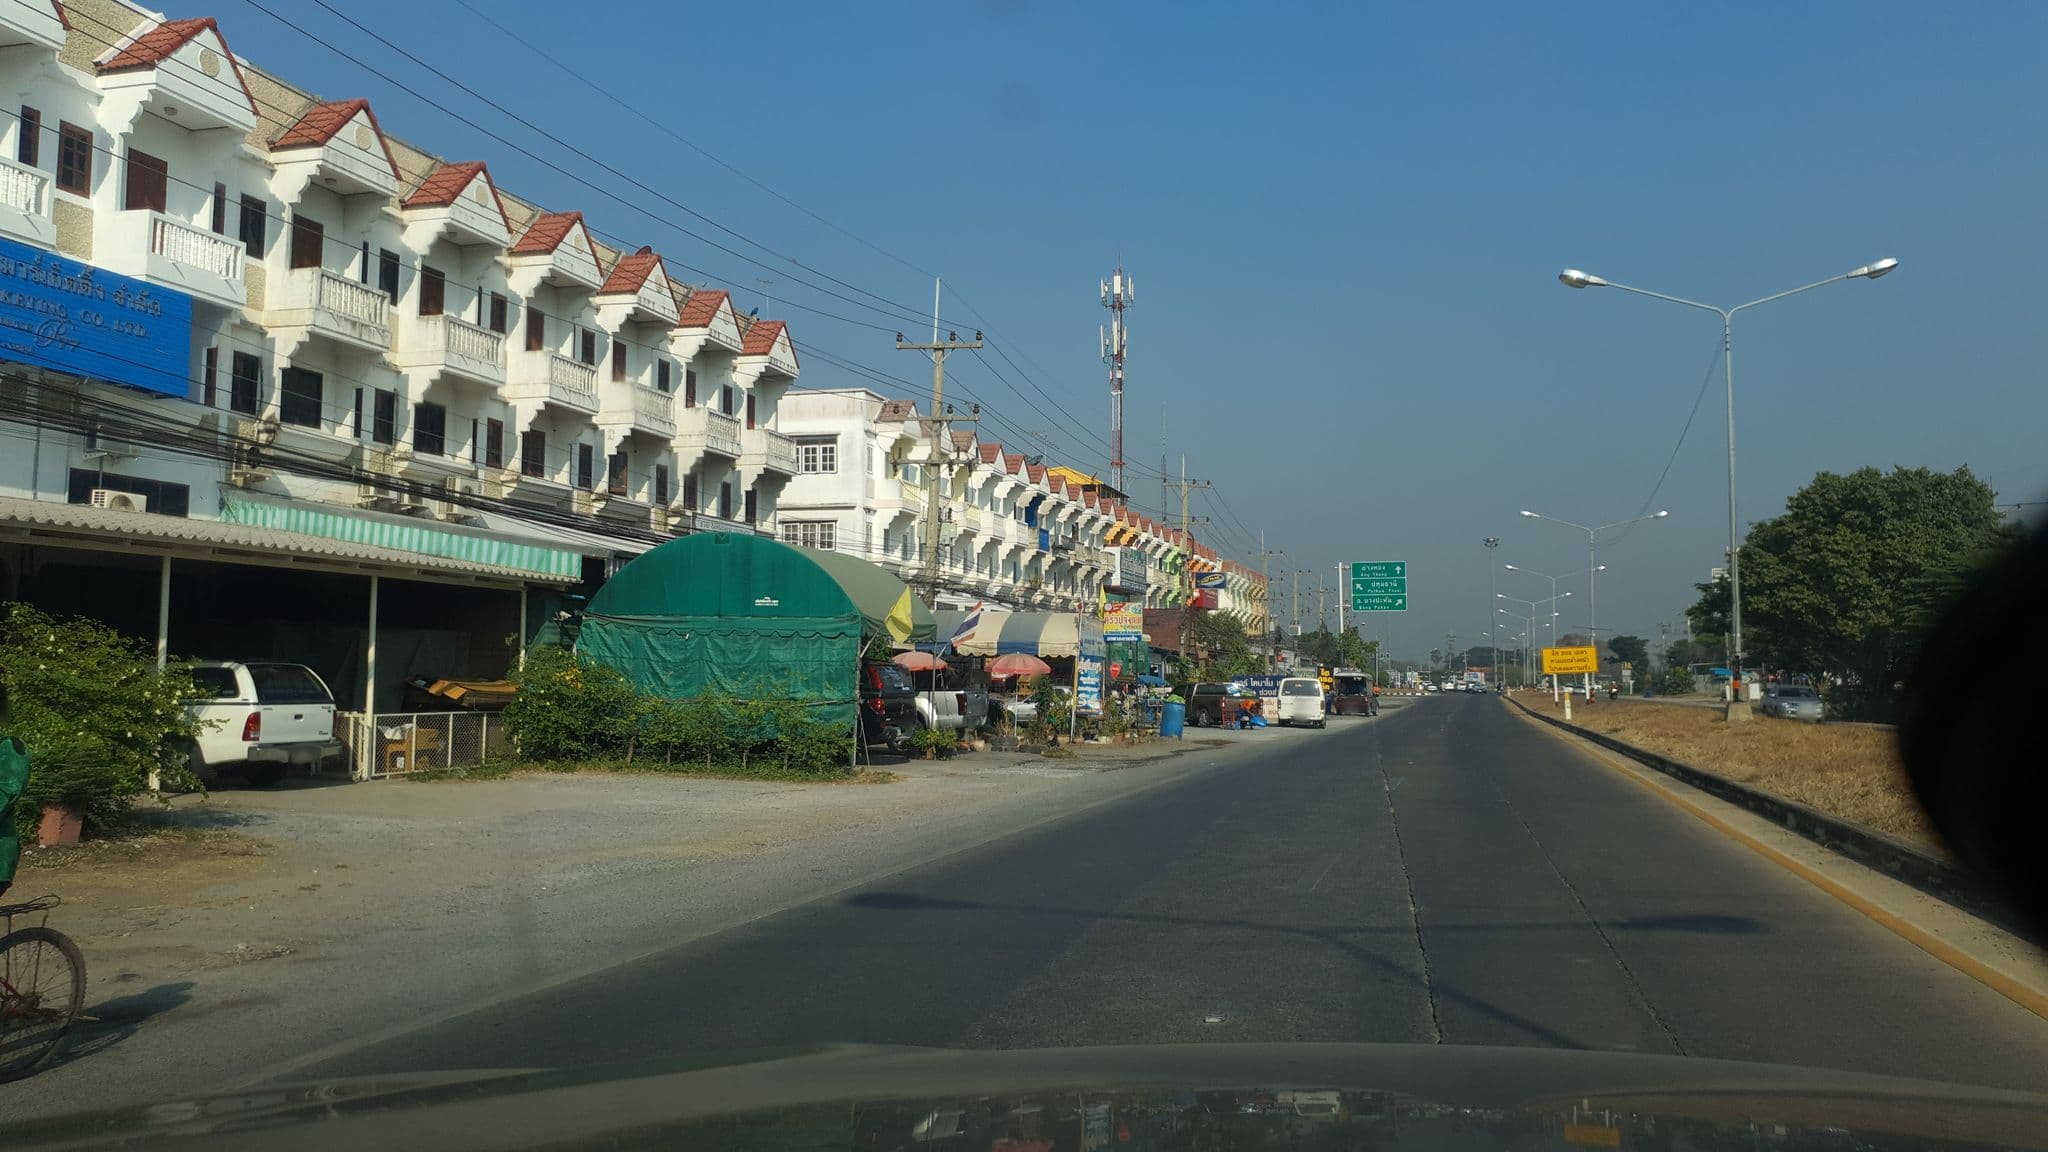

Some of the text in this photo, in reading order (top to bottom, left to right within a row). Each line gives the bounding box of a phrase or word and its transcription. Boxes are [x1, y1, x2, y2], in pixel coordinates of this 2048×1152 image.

[112, 283, 162, 317] จำกัด
[1371, 579, 1398, 589] ปทุมธานี
[1250, 677, 1273, 687] ไดนาโม
